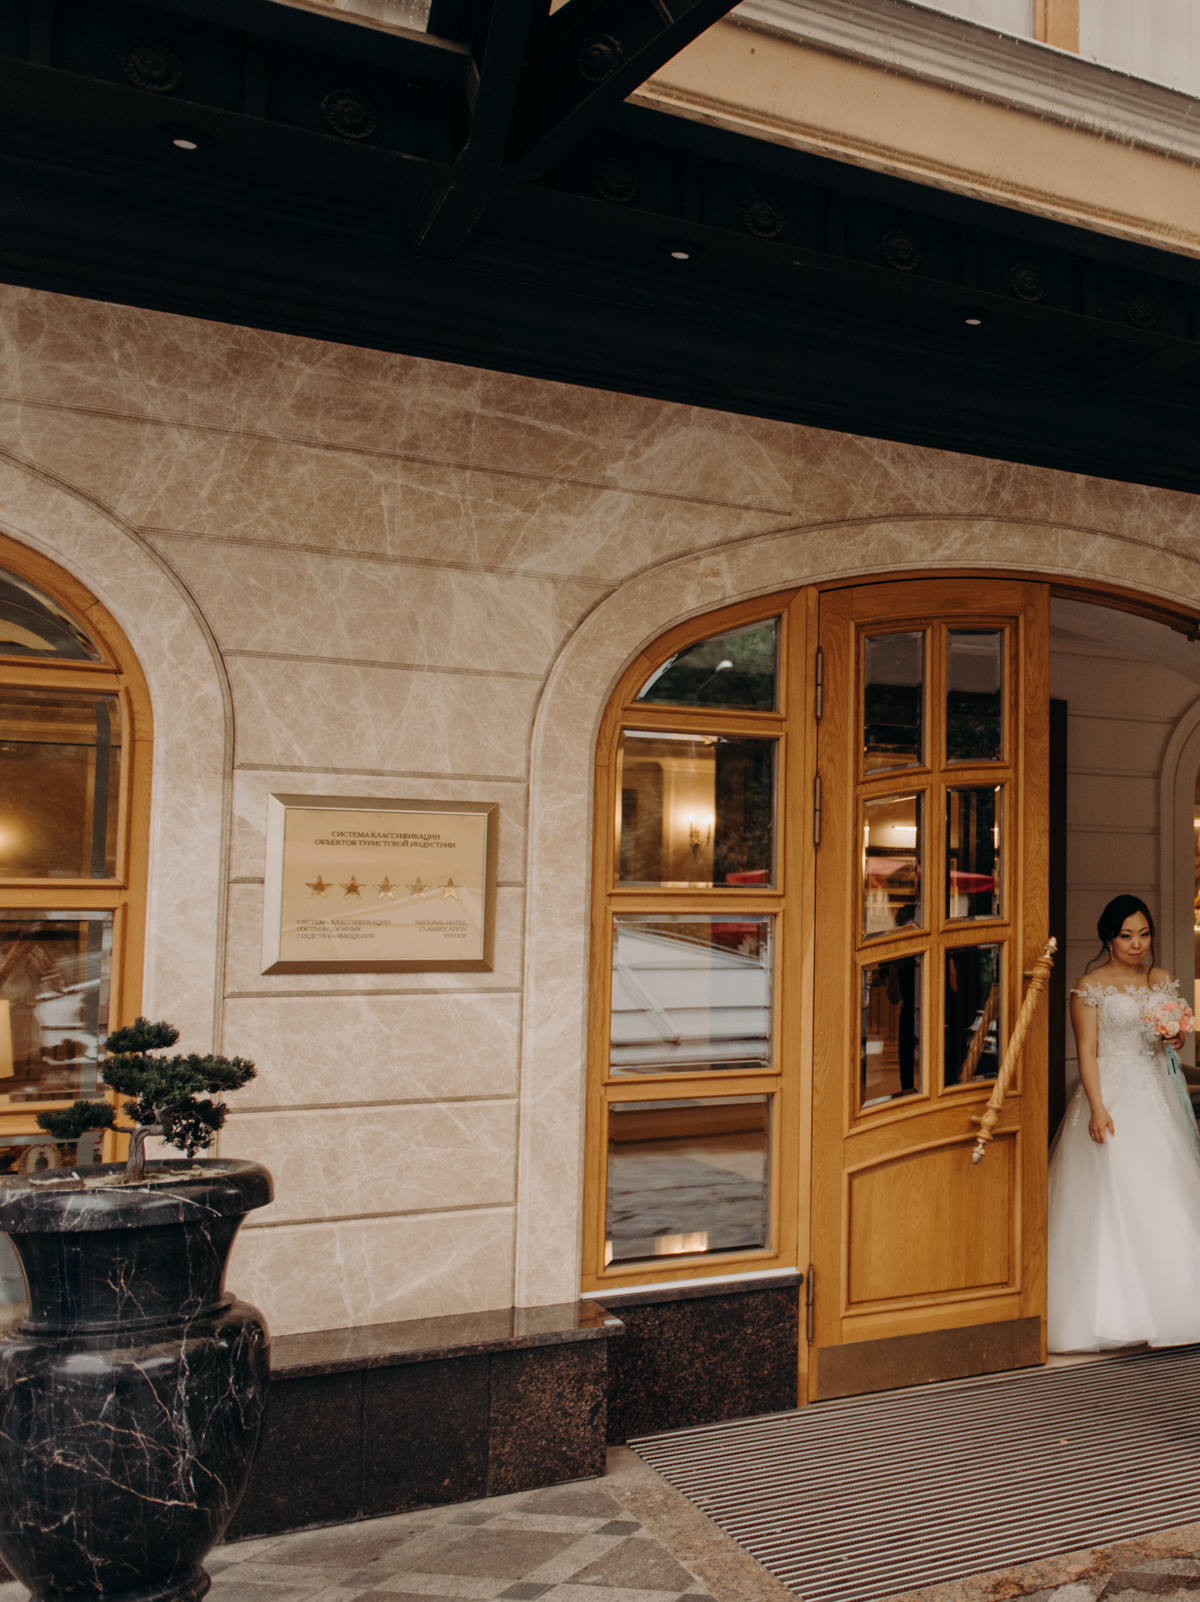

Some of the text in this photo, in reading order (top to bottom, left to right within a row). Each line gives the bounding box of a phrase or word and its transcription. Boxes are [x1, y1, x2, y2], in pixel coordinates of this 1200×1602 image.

[331, 831, 441, 841] СИСТЕМА КЛАССИФИКАЦИИ
[314, 838, 457, 849] ОБЪЕКТОВ ТУРИСТСКОЙ ИНДУСТРИИ
